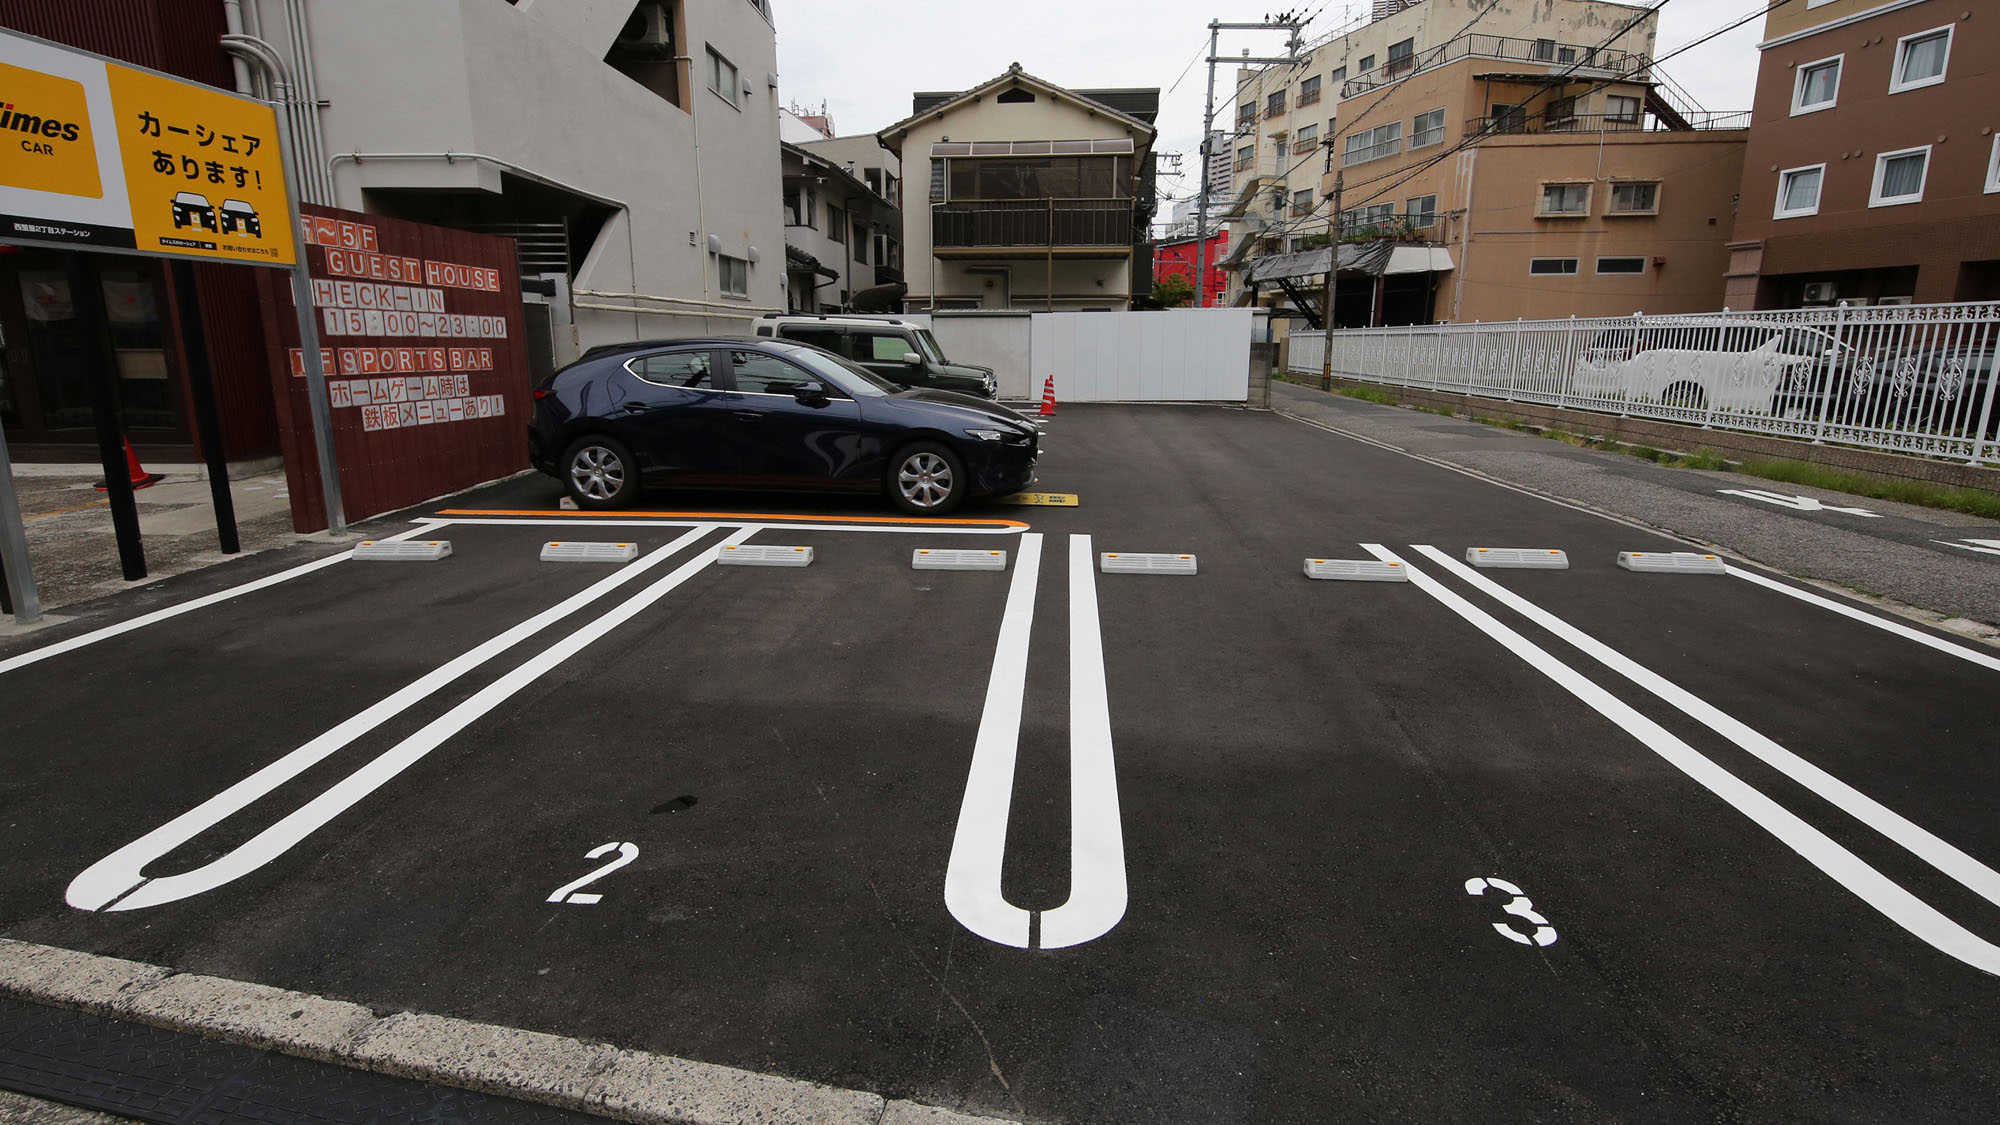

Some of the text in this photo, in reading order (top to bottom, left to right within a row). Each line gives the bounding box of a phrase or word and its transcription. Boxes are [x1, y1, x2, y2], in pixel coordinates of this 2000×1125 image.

[0, 102, 80, 142] imes
[138, 111, 260, 156] カーシェア
[21, 140, 54, 156] CAR
[329, 251, 498, 290] GUEST HOUSE
[343, 351, 443, 371] SPORTS
[452, 351, 491, 369] BAR
[332, 377, 468, 404] ホームゲーム時は
[545, 841, 640, 904] 2
[1464, 877, 1558, 947] 3
